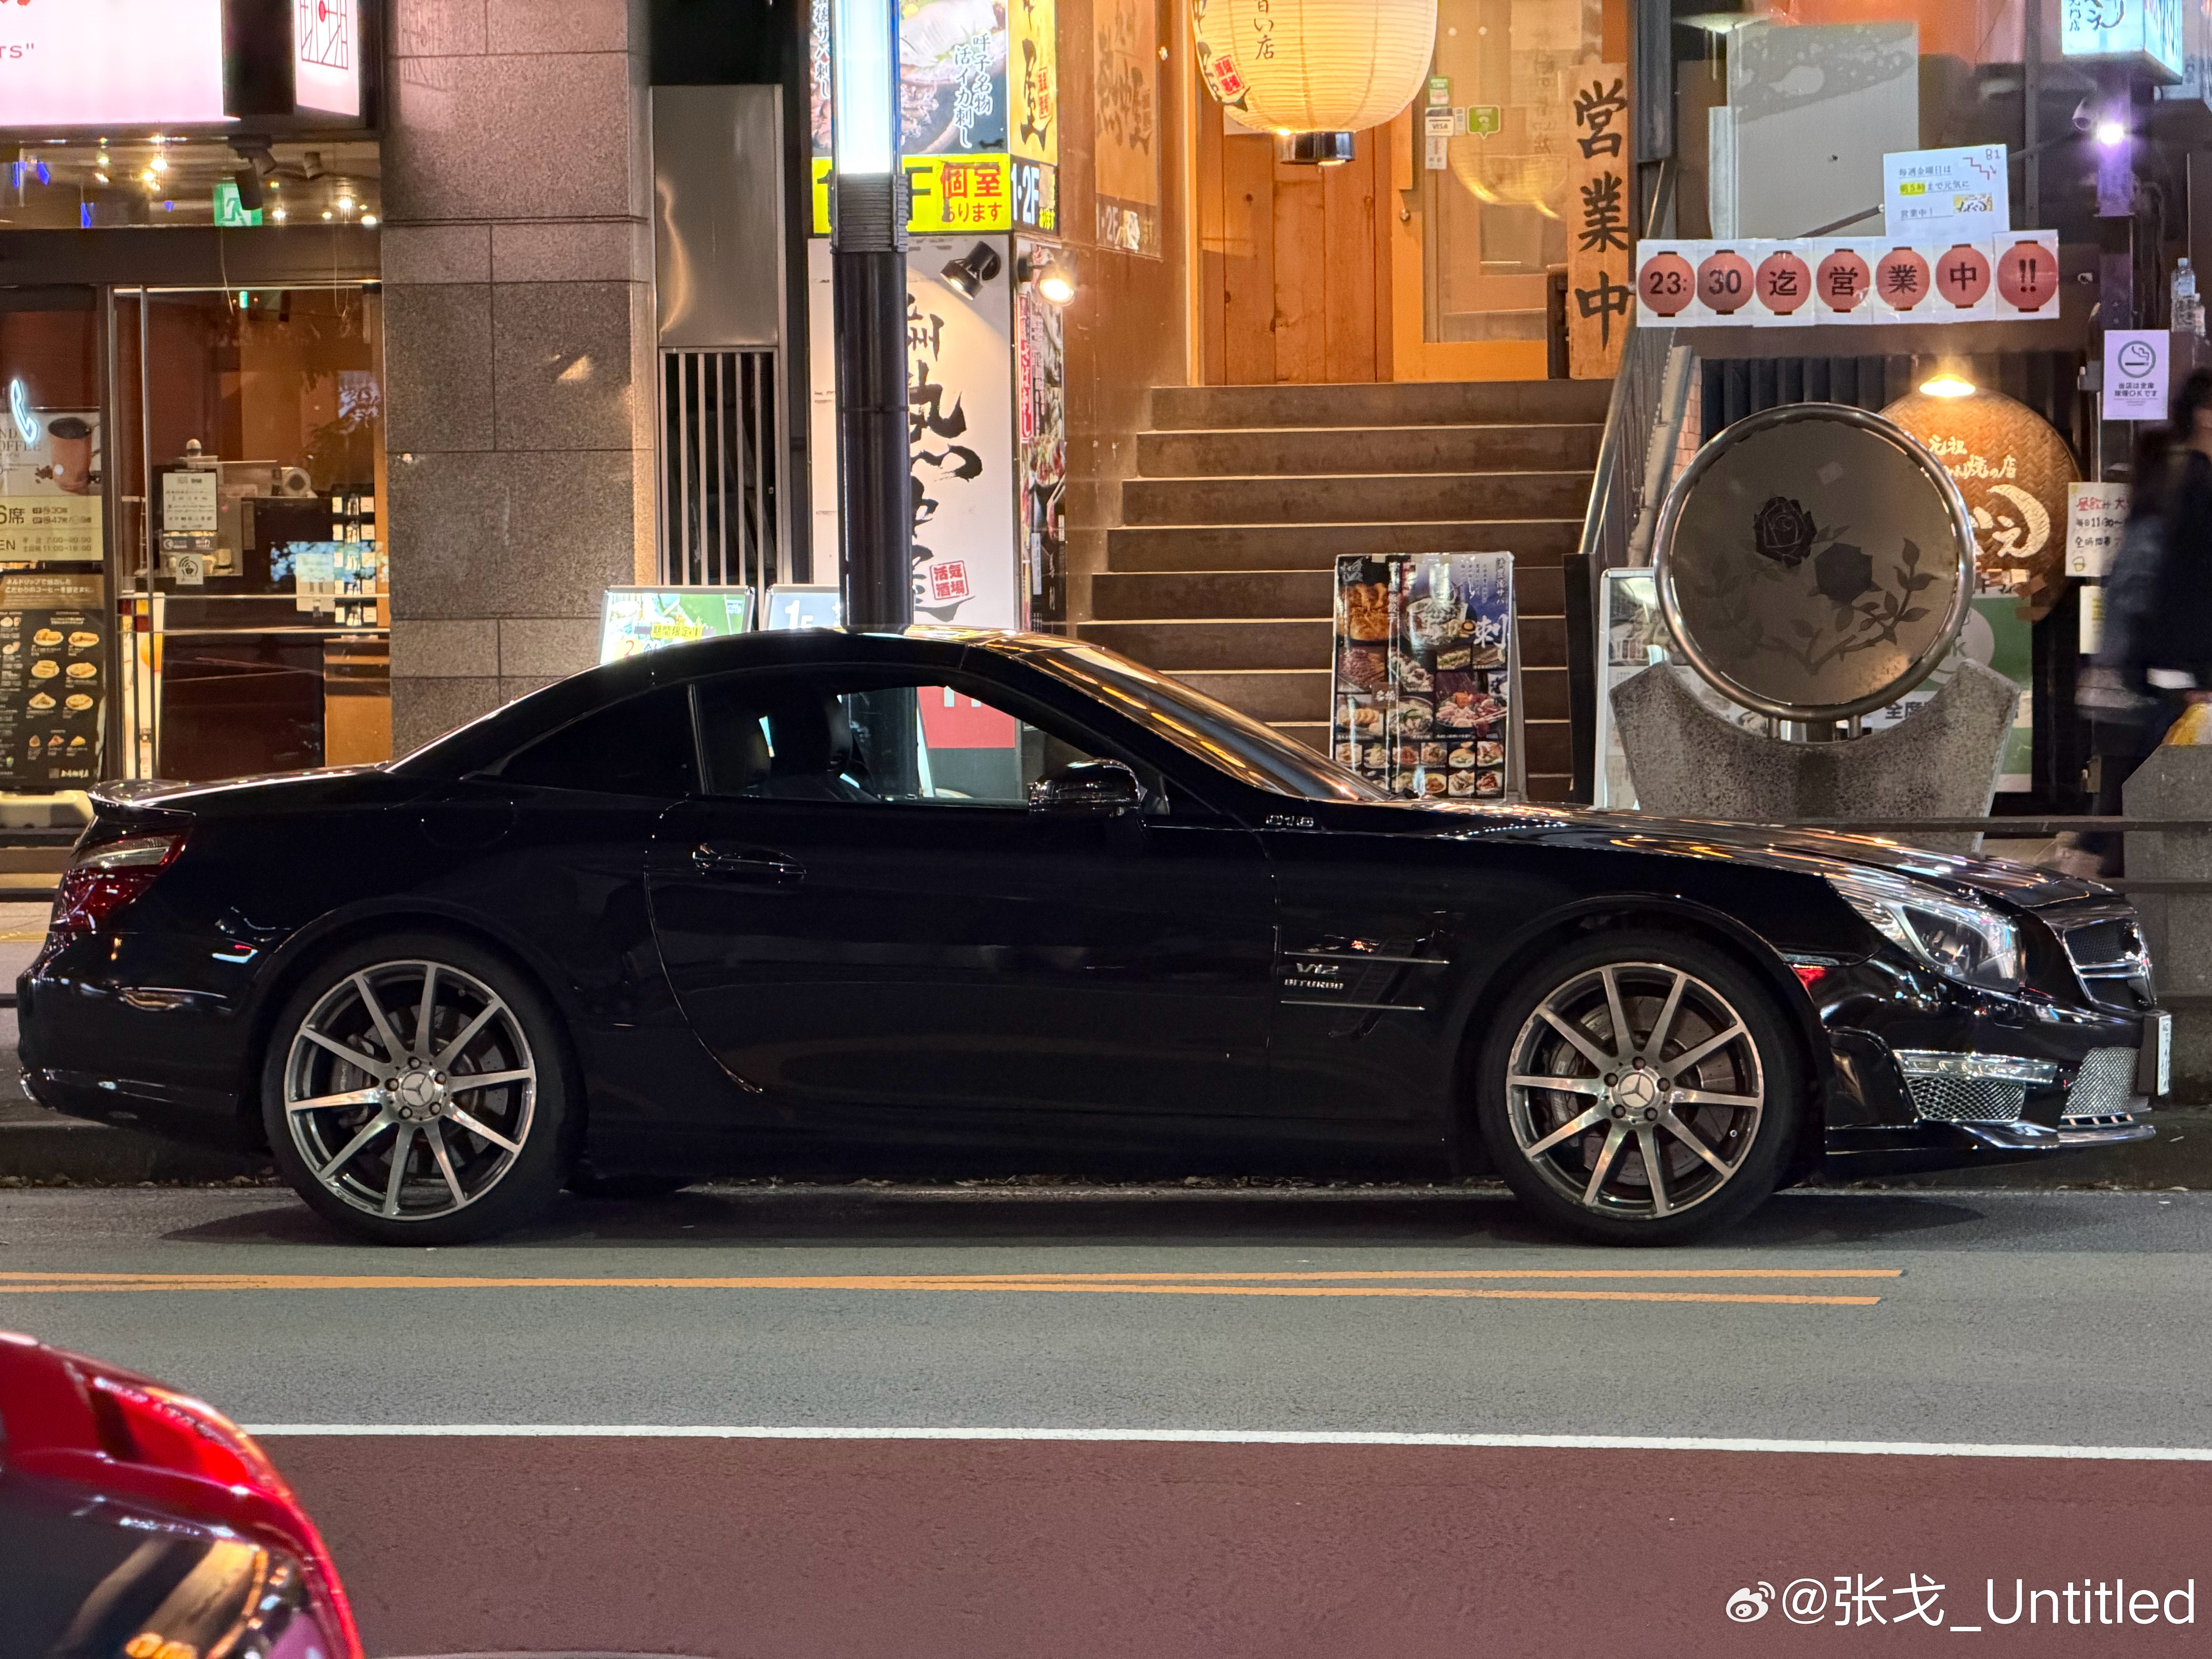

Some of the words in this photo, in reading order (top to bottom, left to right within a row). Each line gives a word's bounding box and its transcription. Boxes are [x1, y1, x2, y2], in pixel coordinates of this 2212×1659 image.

[954, 45, 974, 149] 活イカ刺し
[972, 33, 993, 115] 呼子名物
[1574, 78, 1628, 351] 営業中
